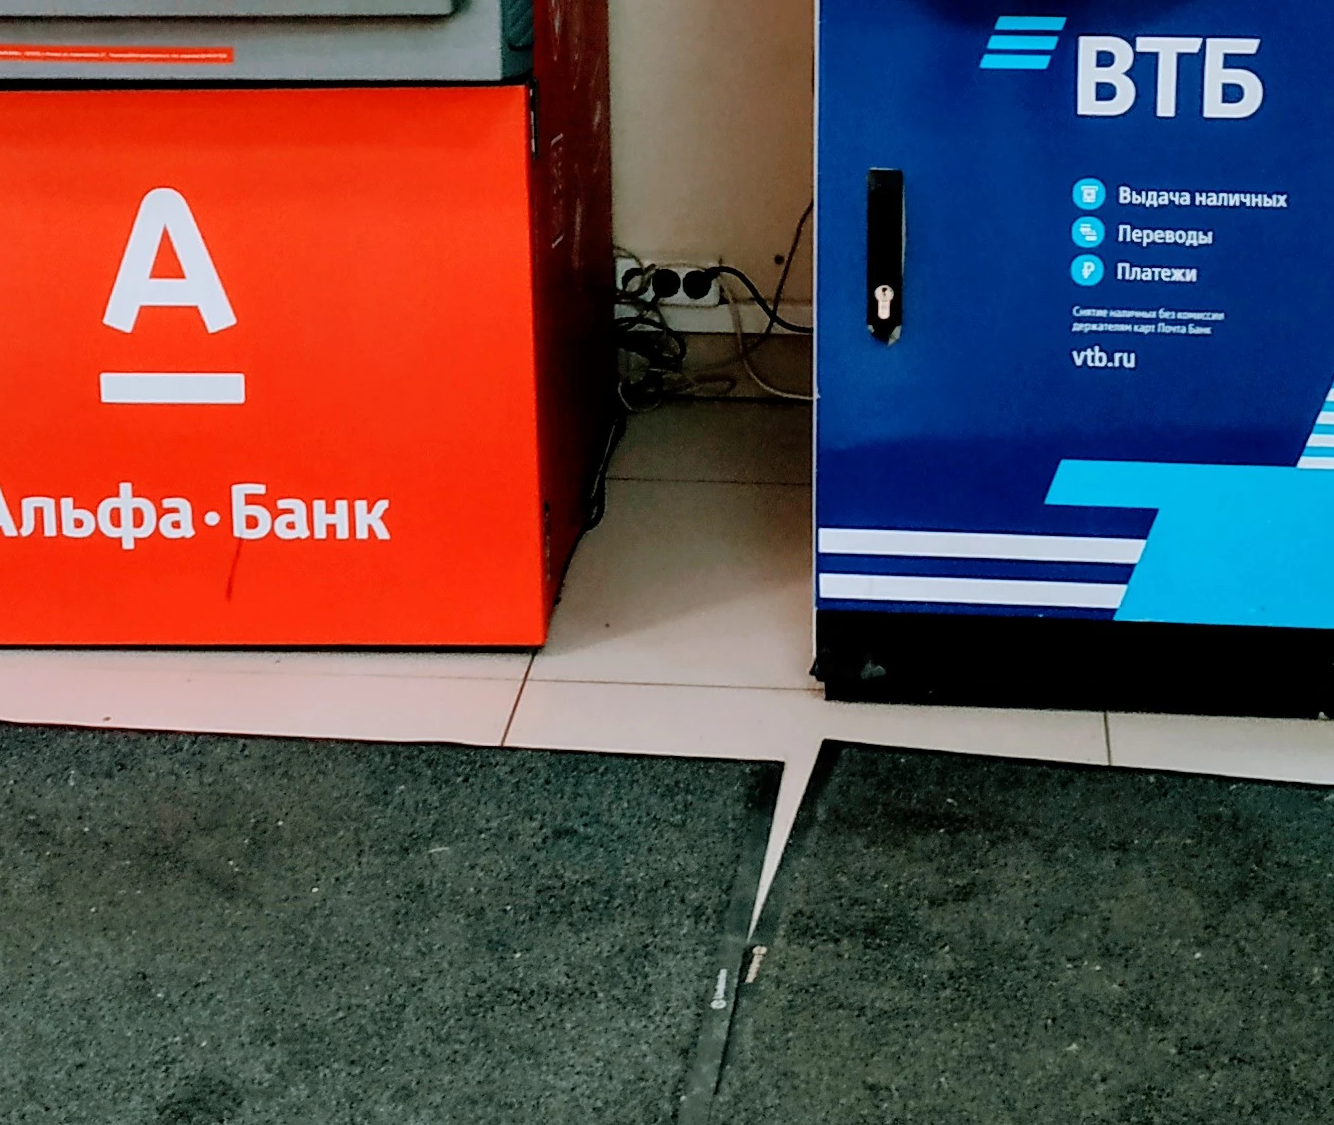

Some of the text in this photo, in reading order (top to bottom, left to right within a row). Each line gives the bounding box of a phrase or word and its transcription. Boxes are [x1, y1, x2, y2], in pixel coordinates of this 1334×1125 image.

[1076, 35, 1264, 119] ВТБ
[1118, 186, 1288, 208] Выдача наличных
[1117, 225, 1214, 247] Переводы
[1116, 262, 1198, 283] Платежи
[1072, 306, 1225, 321] Снятие наличных без комиссии
[1071, 322, 1213, 335] держателям карт Почта Банк
[1071, 345, 1136, 368] vtb.ru
